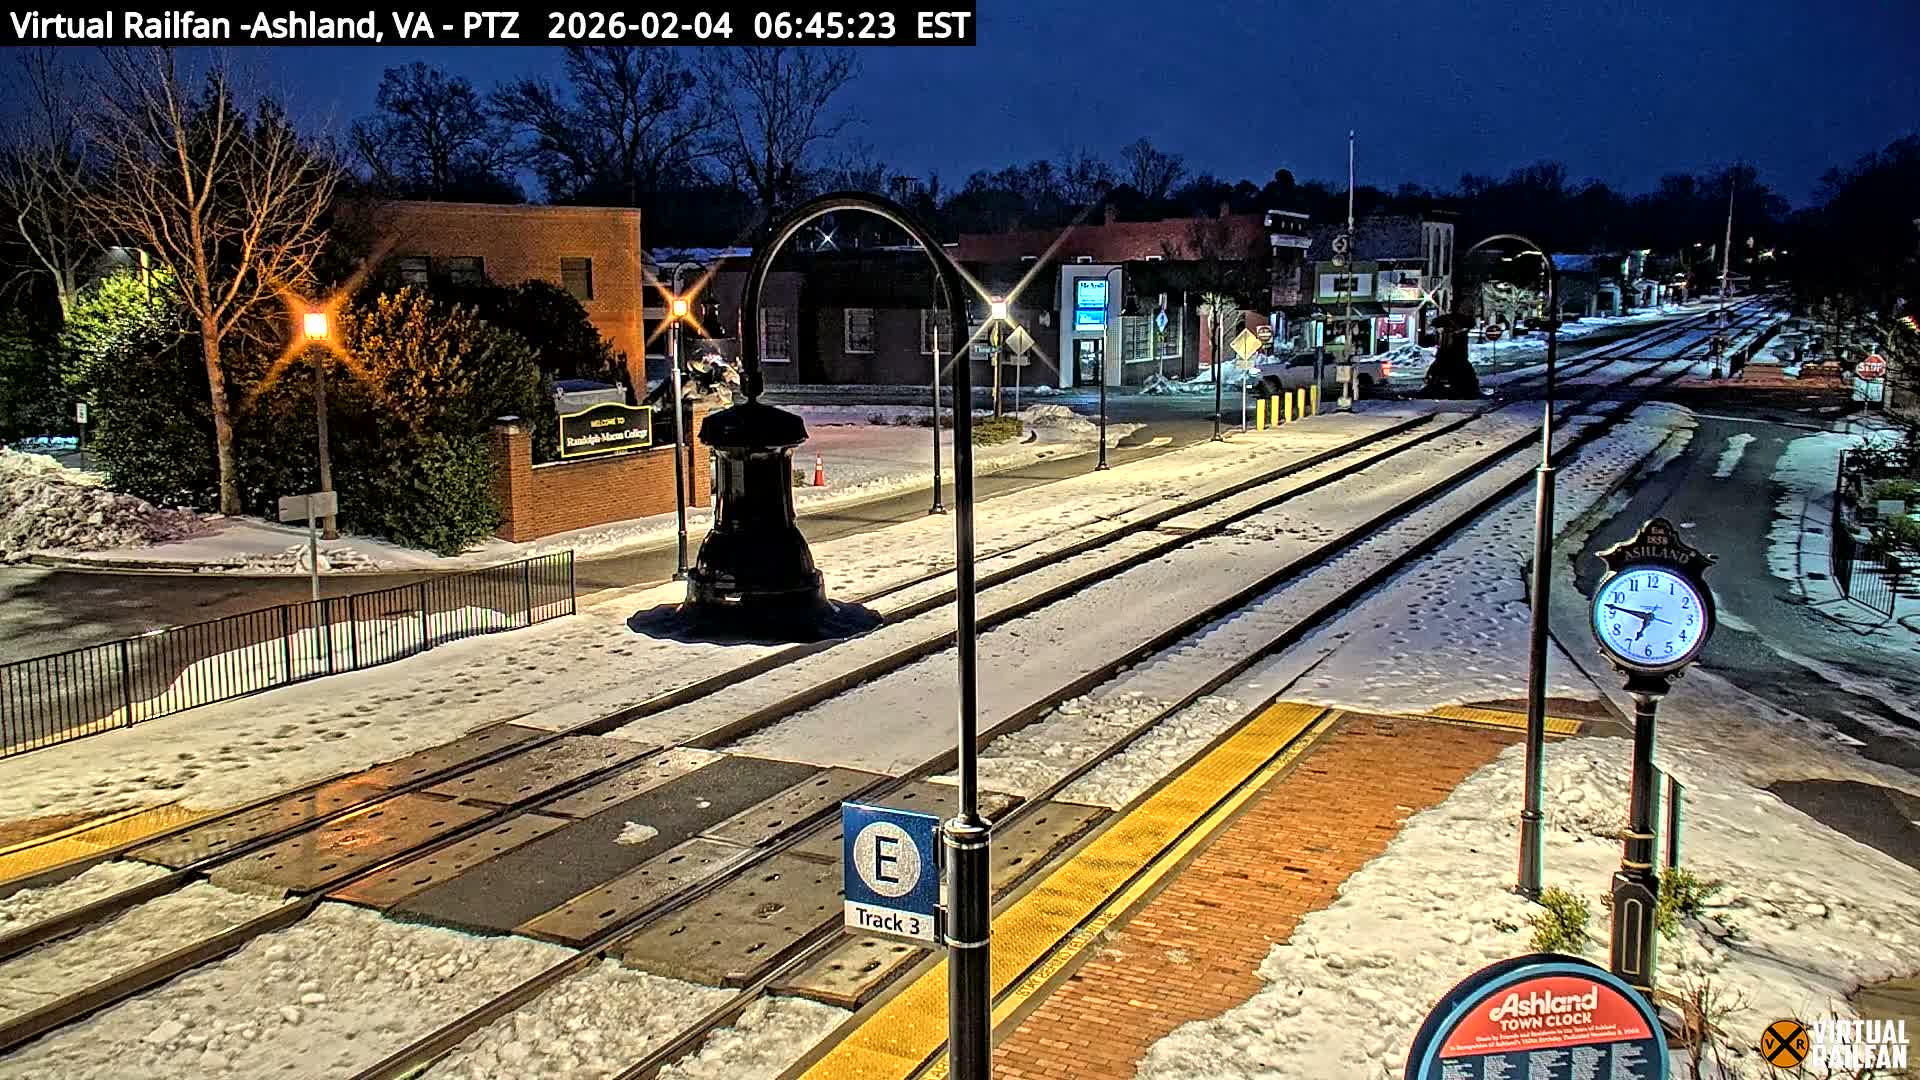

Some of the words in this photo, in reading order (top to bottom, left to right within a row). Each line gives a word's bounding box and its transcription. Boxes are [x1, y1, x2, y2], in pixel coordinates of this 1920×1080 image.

[1859, 363, 1883, 372] STOP
[1625, 546, 1690, 564] ASHLAND
[1630, 579, 1639, 592] 11
[1647, 575, 1659, 588] 12
[1669, 583, 1675, 595] 1
[1613, 591, 1625, 604] 10
[1681, 596, 1690, 609] 2
[1609, 608, 1617, 620] 9
[1686, 614, 1694, 626] 3
[1612, 623, 1622, 636] 8
[1679, 629, 1688, 642] 4
[1625, 638, 1633, 650] 7
[1645, 644, 1653, 657] 6
[1664, 642, 1674, 653] 5
[875, 835, 899, 883] E
[856, 907, 903, 932] Track
[909, 918, 920, 935] 3
[1489, 986, 1598, 1022] Ashland
[1500, 1016, 1543, 1031] TOWN
[1545, 1012, 1592, 1027] CLOCK
